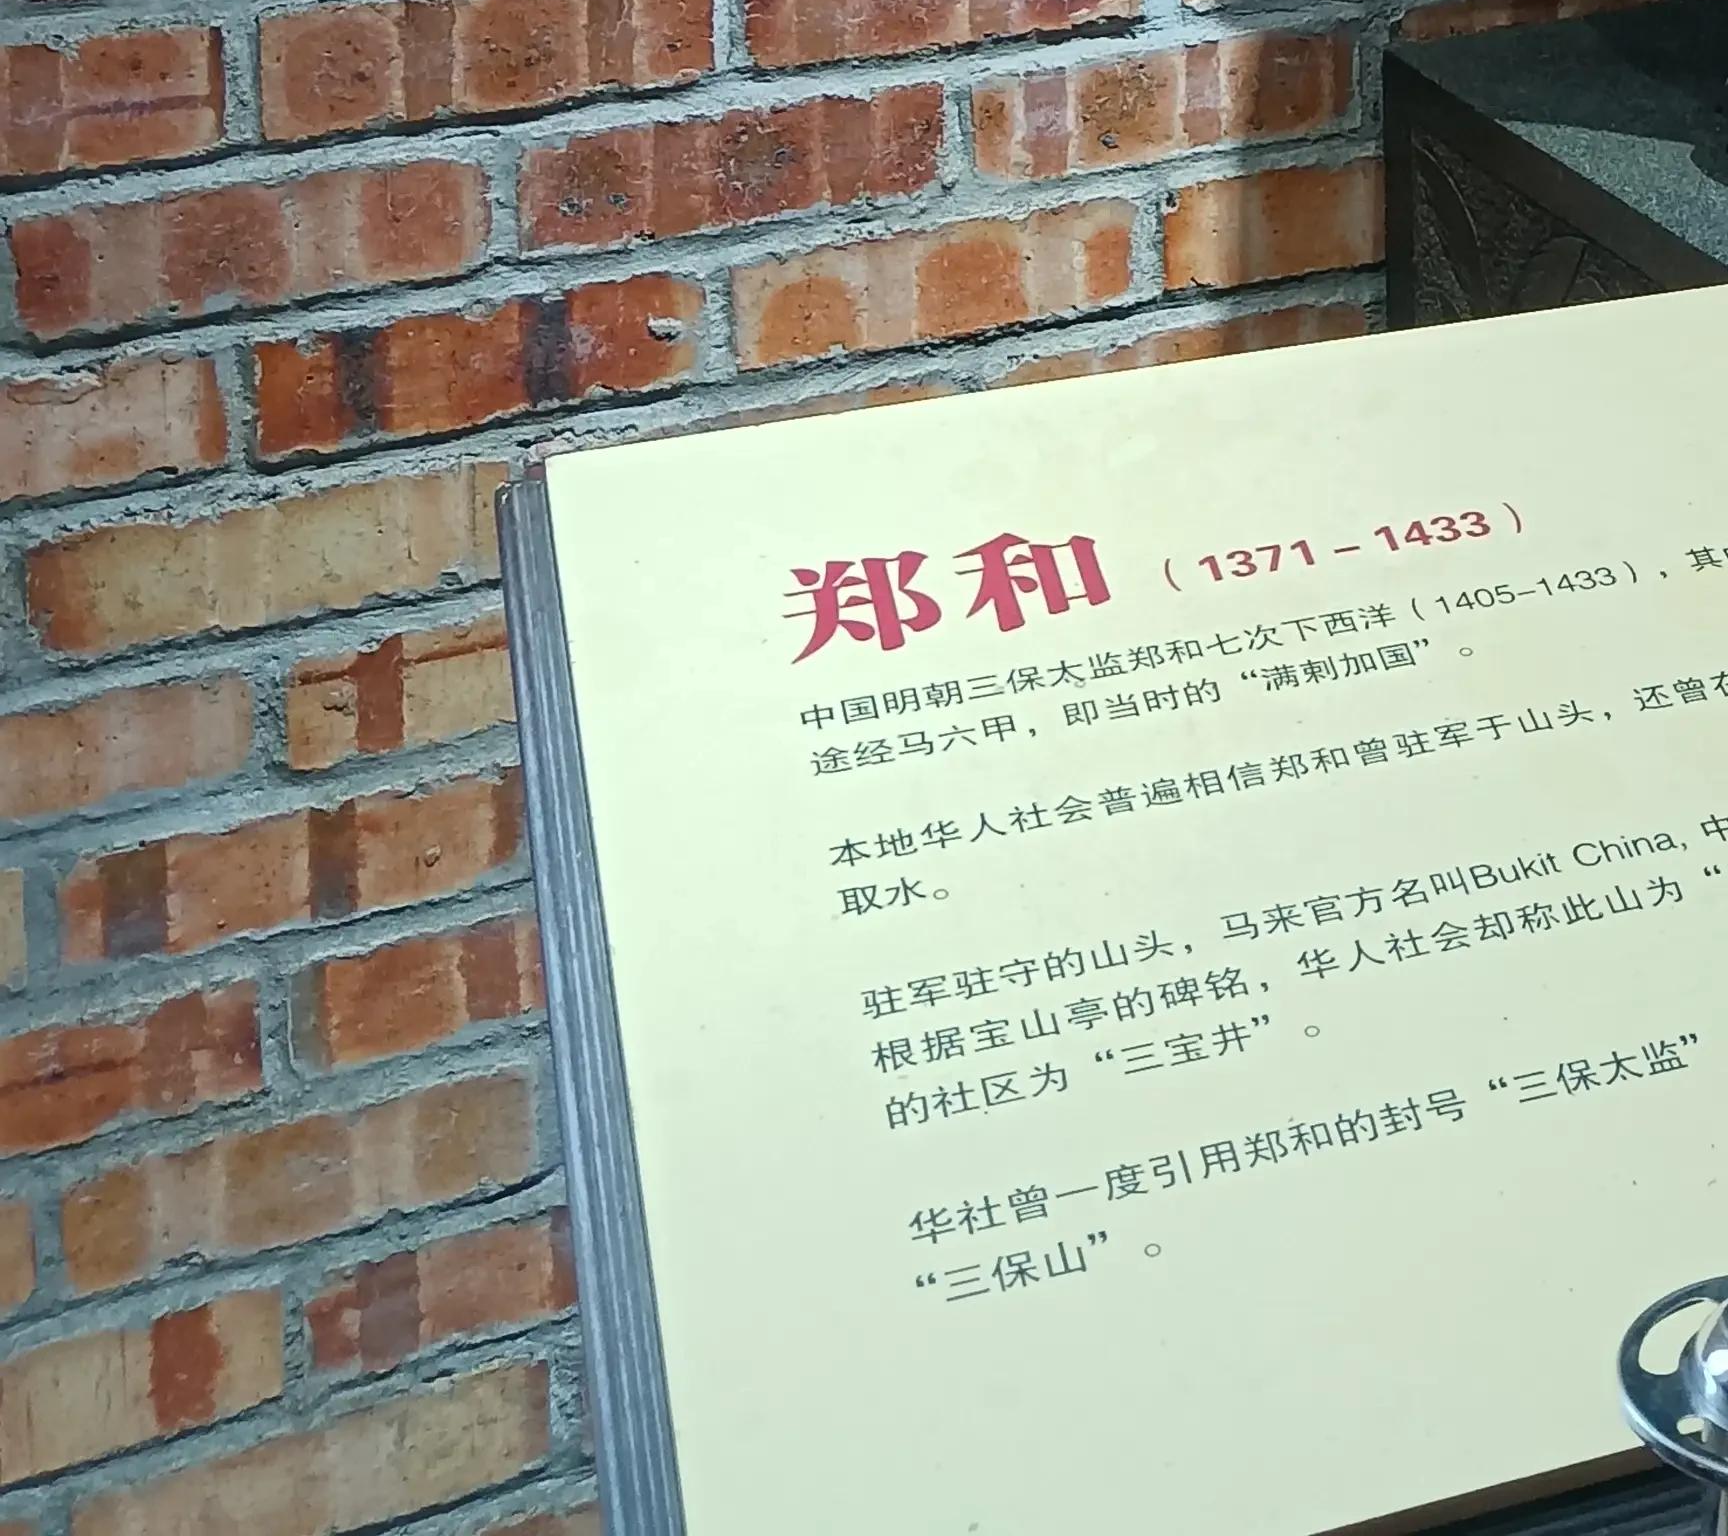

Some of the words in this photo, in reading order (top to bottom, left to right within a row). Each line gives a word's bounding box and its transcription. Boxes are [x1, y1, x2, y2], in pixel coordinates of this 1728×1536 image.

[782, 532, 1111, 665] 郑和
[1573, 831, 1689, 867] China,
[837, 877, 950, 917] 取水。
[915, 1231, 1162, 1303] “三保山”。
